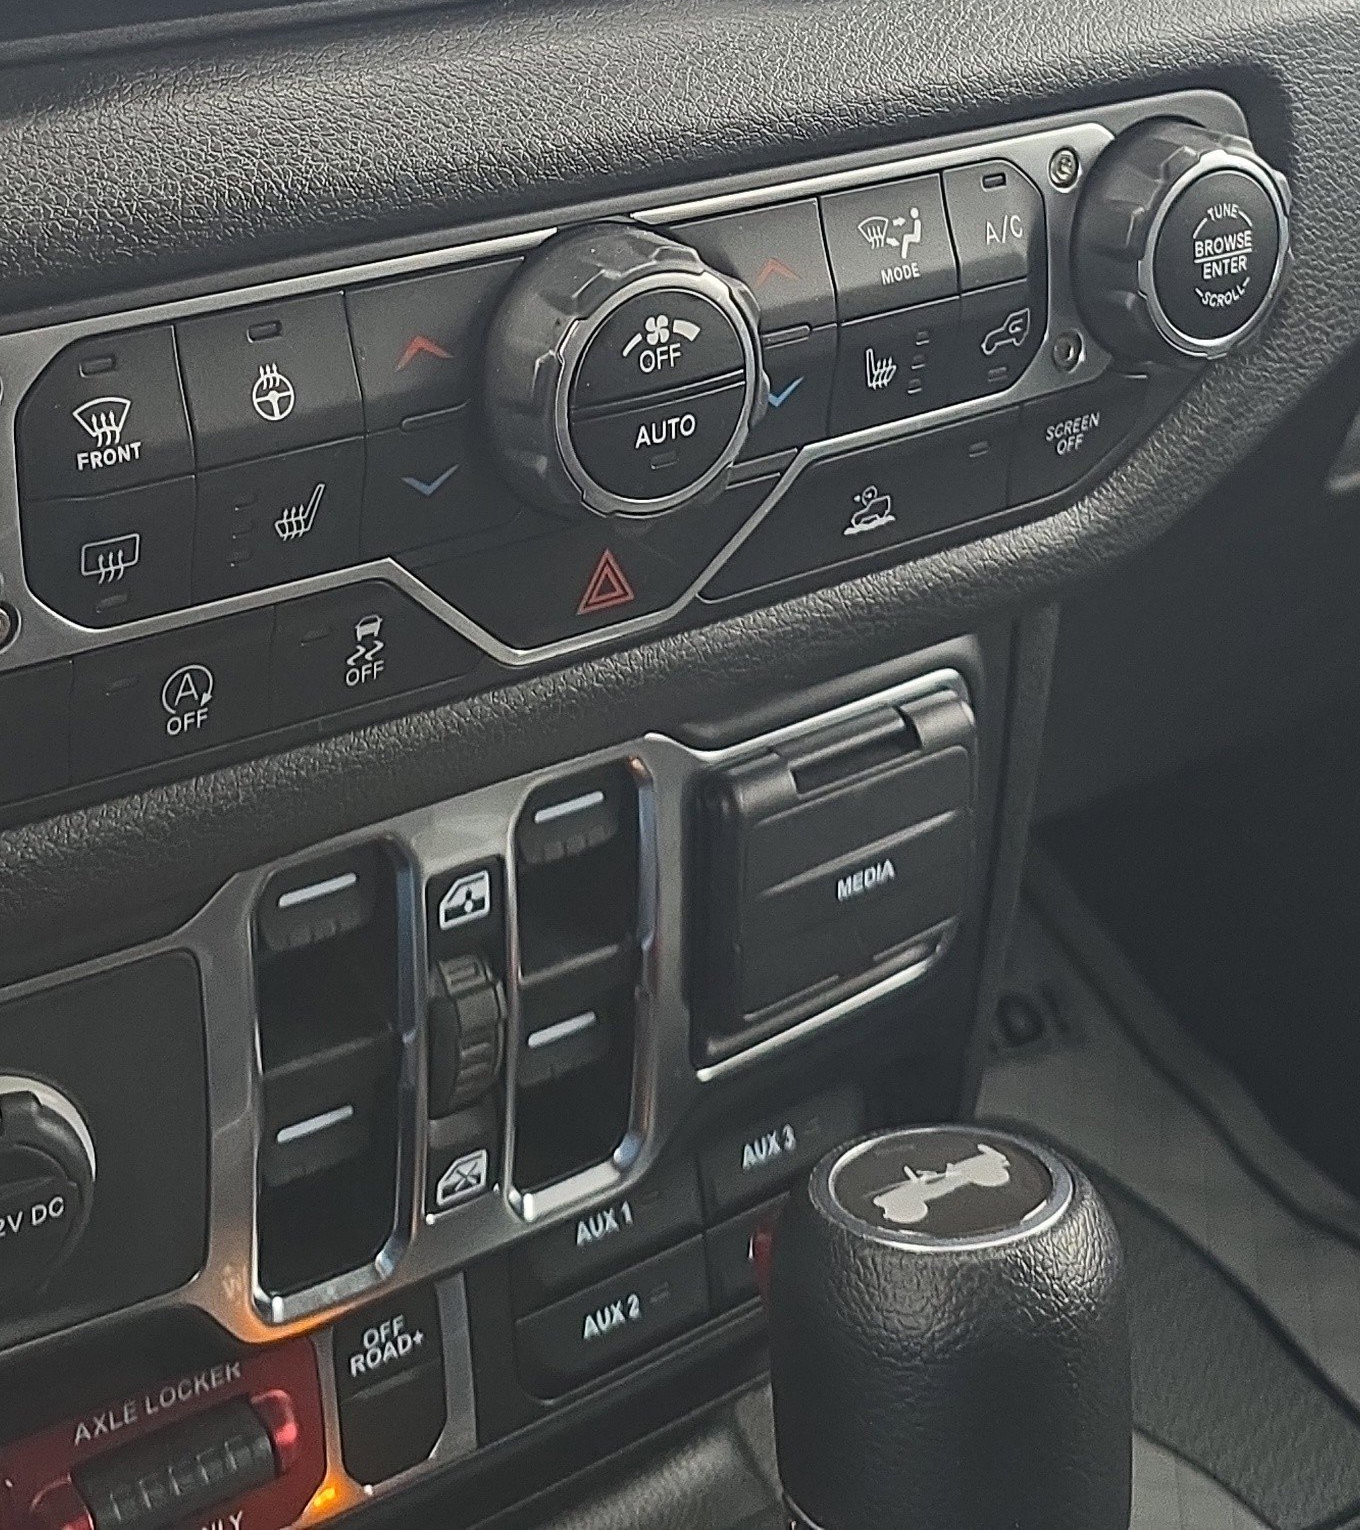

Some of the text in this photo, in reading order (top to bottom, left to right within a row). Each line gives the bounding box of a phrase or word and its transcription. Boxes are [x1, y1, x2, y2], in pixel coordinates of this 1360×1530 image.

[1207, 203, 1240, 221] TUNE
[985, 214, 1024, 246] A/C
[1194, 230, 1252, 258] BROWSE
[880, 263, 921, 287] MODE
[1203, 255, 1247, 280] ENTER
[1202, 285, 1246, 307] SCROLL
[639, 342, 682, 373] OFF
[635, 414, 696, 449] AUTO
[1045, 412, 1100, 443] SCREEN
[76, 441, 142, 471] FRONT
[1056, 433, 1085, 456] OFF
[345, 660, 385, 687] OFF
[166, 708, 209, 736] OFF
[836, 858, 896, 901] MEDIA
[742, 1123, 796, 1170] AUX 3
[31, 1196, 64, 1226] DC
[576, 1200, 633, 1247] AUX 1
[583, 1293, 640, 1339] AUX 2
[363, 1314, 404, 1350] OFF
[350, 1329, 424, 1378] ROAD+
[73, 1361, 242, 1447] AXLE LOCKER
